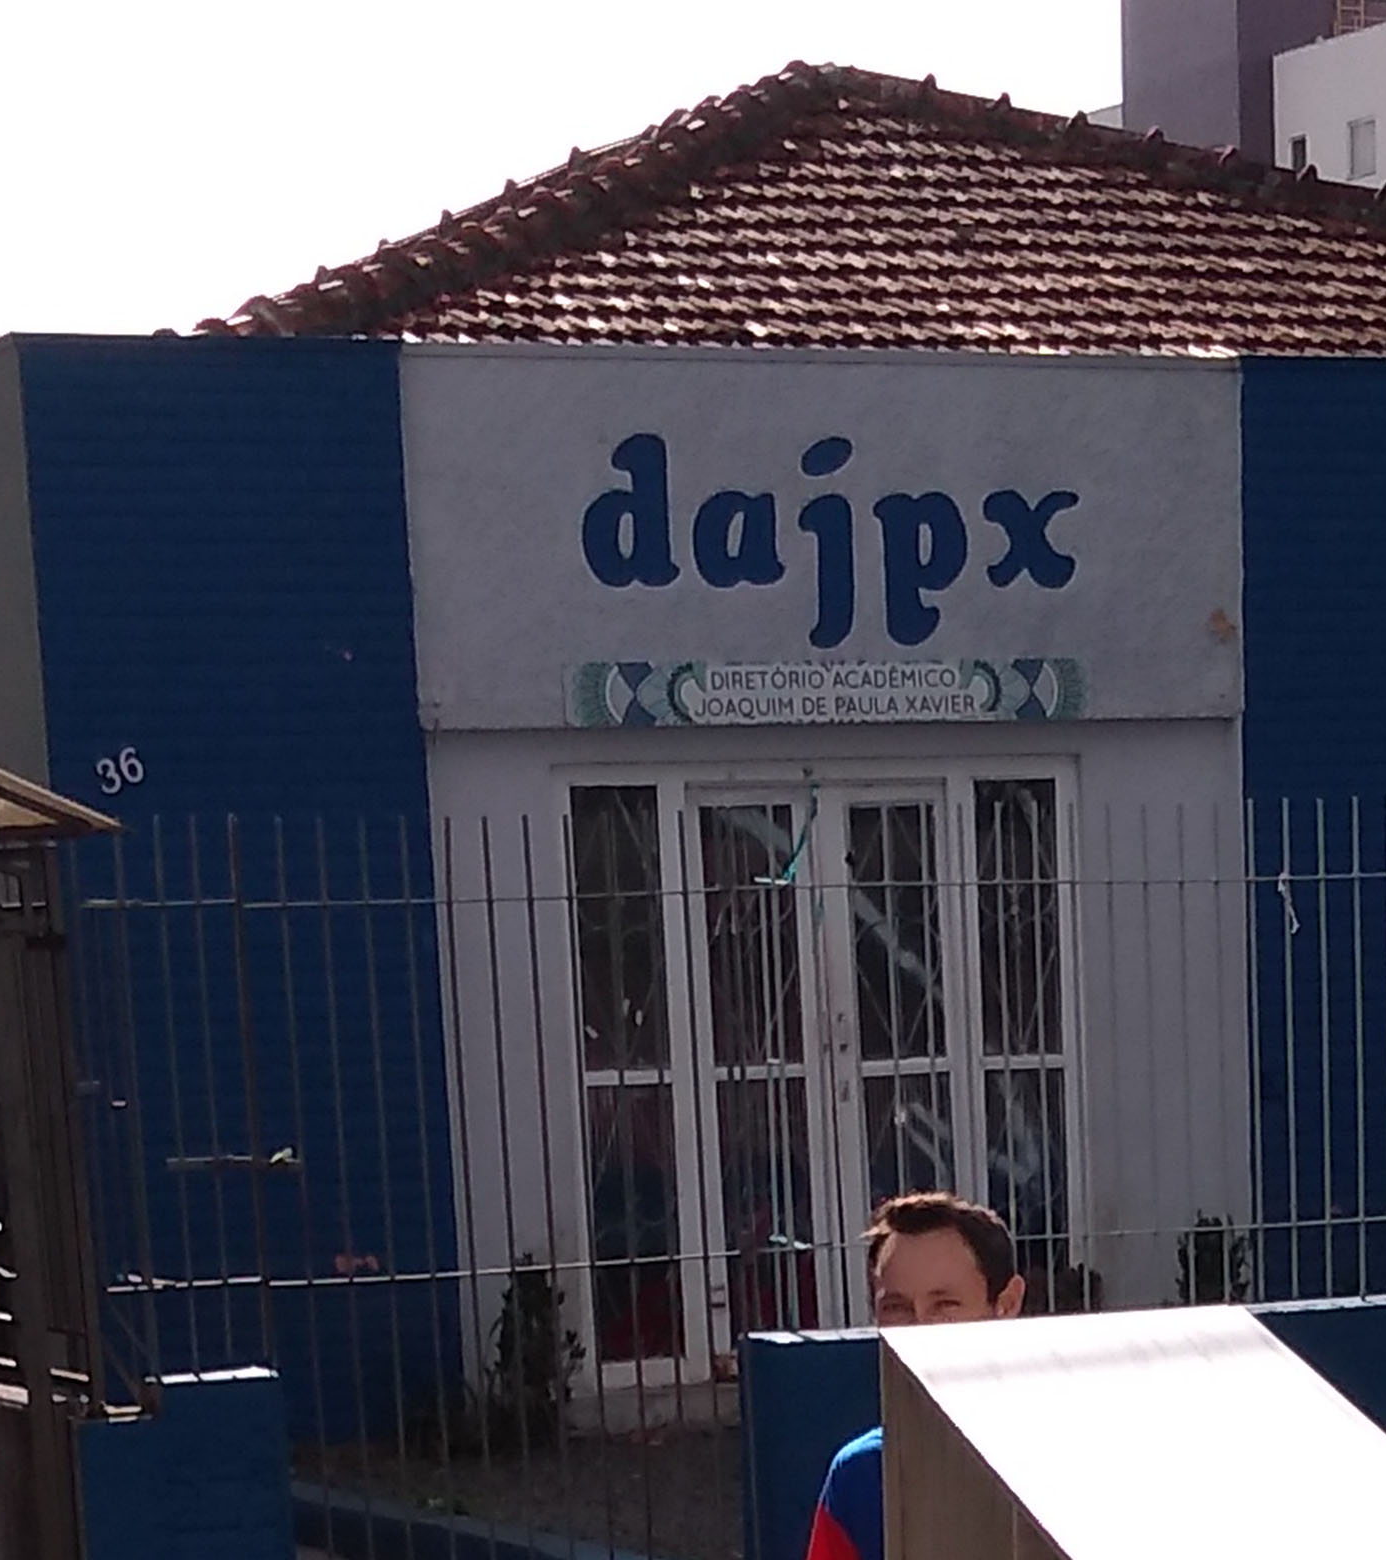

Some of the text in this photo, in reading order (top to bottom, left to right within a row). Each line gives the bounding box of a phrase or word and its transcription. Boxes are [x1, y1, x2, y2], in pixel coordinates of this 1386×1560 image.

[582, 432, 1080, 649] dajpx
[710, 667, 957, 691] DIRETÓRIO ACADÊMICO
[693, 694, 976, 719] JOAQUIM DE PAULA XAVIER
[95, 746, 144, 794] 36
